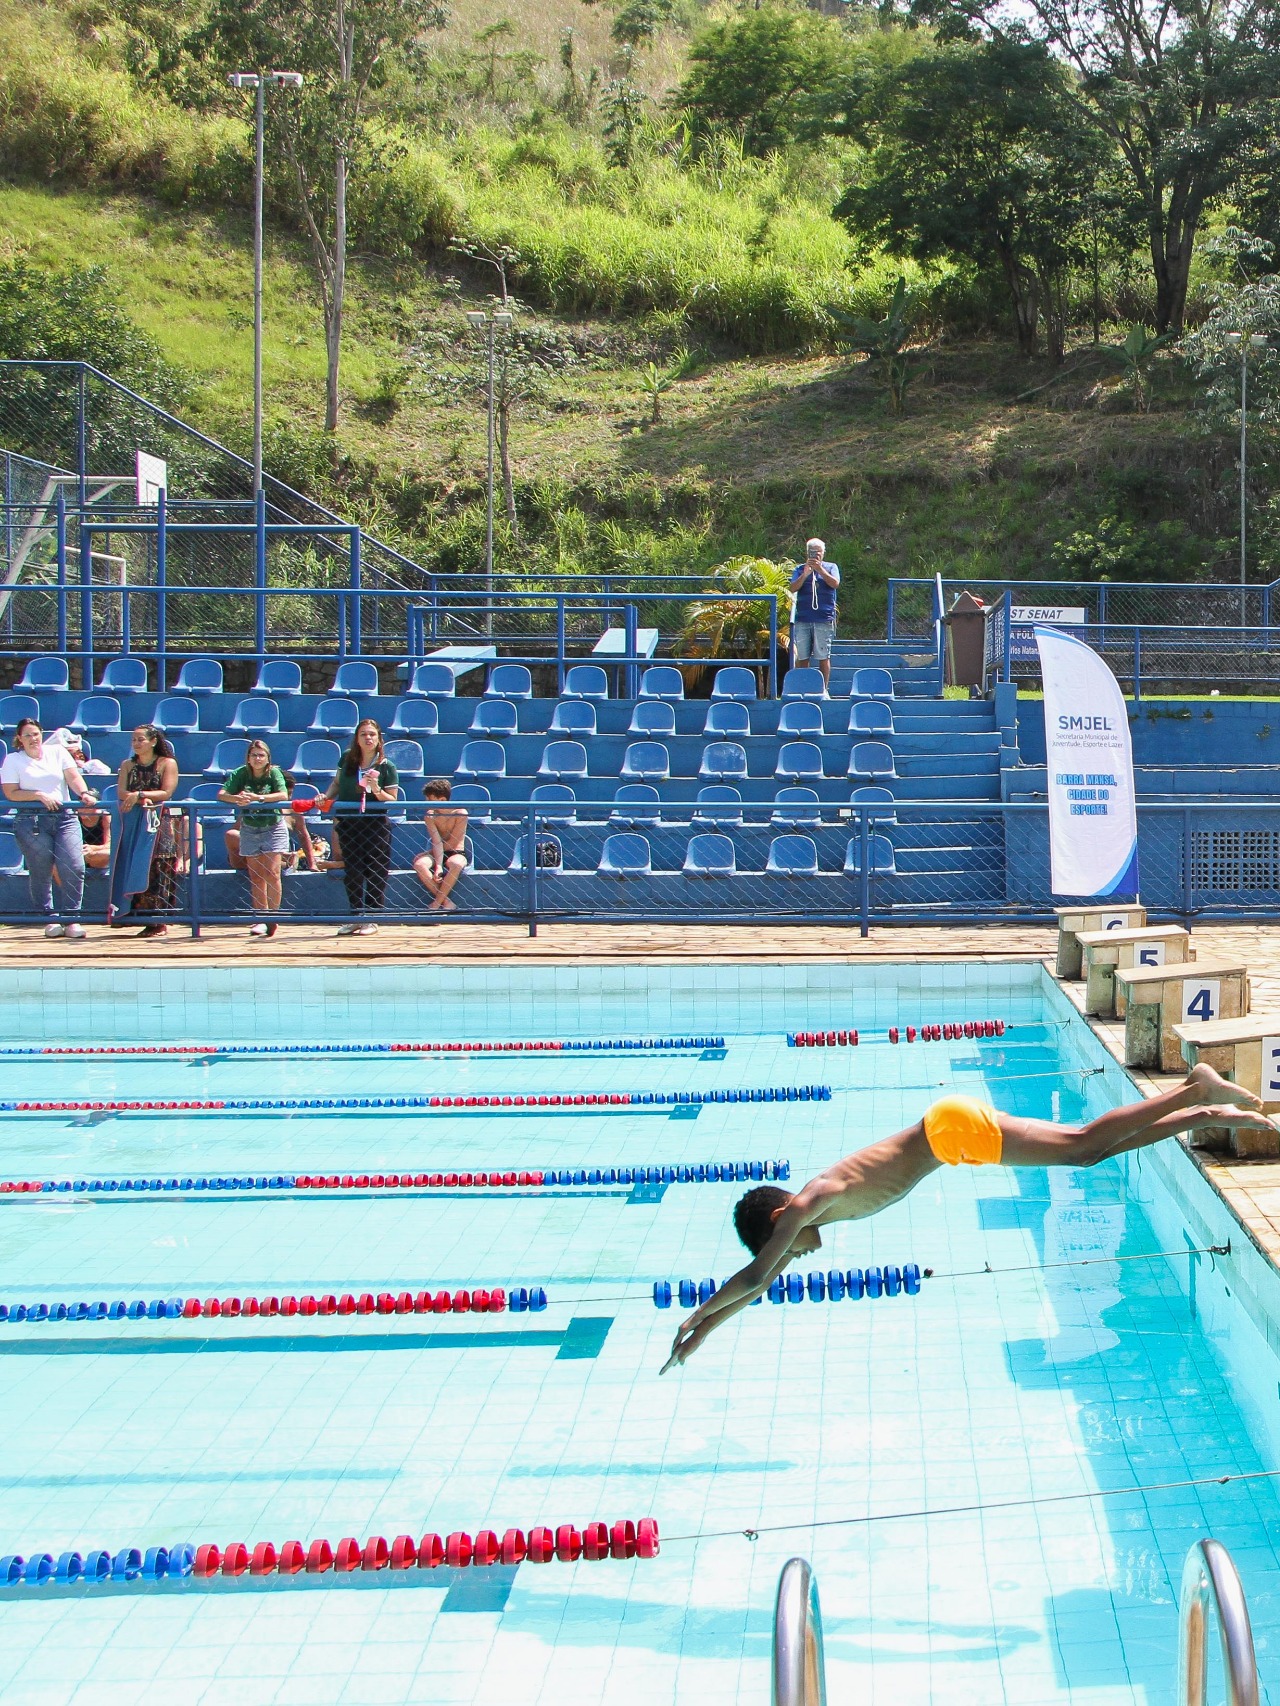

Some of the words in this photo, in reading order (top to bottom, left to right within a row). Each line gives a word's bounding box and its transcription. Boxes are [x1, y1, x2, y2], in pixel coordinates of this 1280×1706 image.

[1027, 609, 1063, 620] SENAT
[1058, 715, 1112, 731] SMJEL
[1085, 733, 1109, 741] Municipal
[1056, 773, 1084, 786] BARRA
[1067, 789, 1097, 800] CIDADE
[1097, 789, 1110, 800] DO
[1070, 803, 1108, 816] ESPORTE!
[1140, 949, 1159, 967] 5
[1187, 989, 1214, 1021] 4
